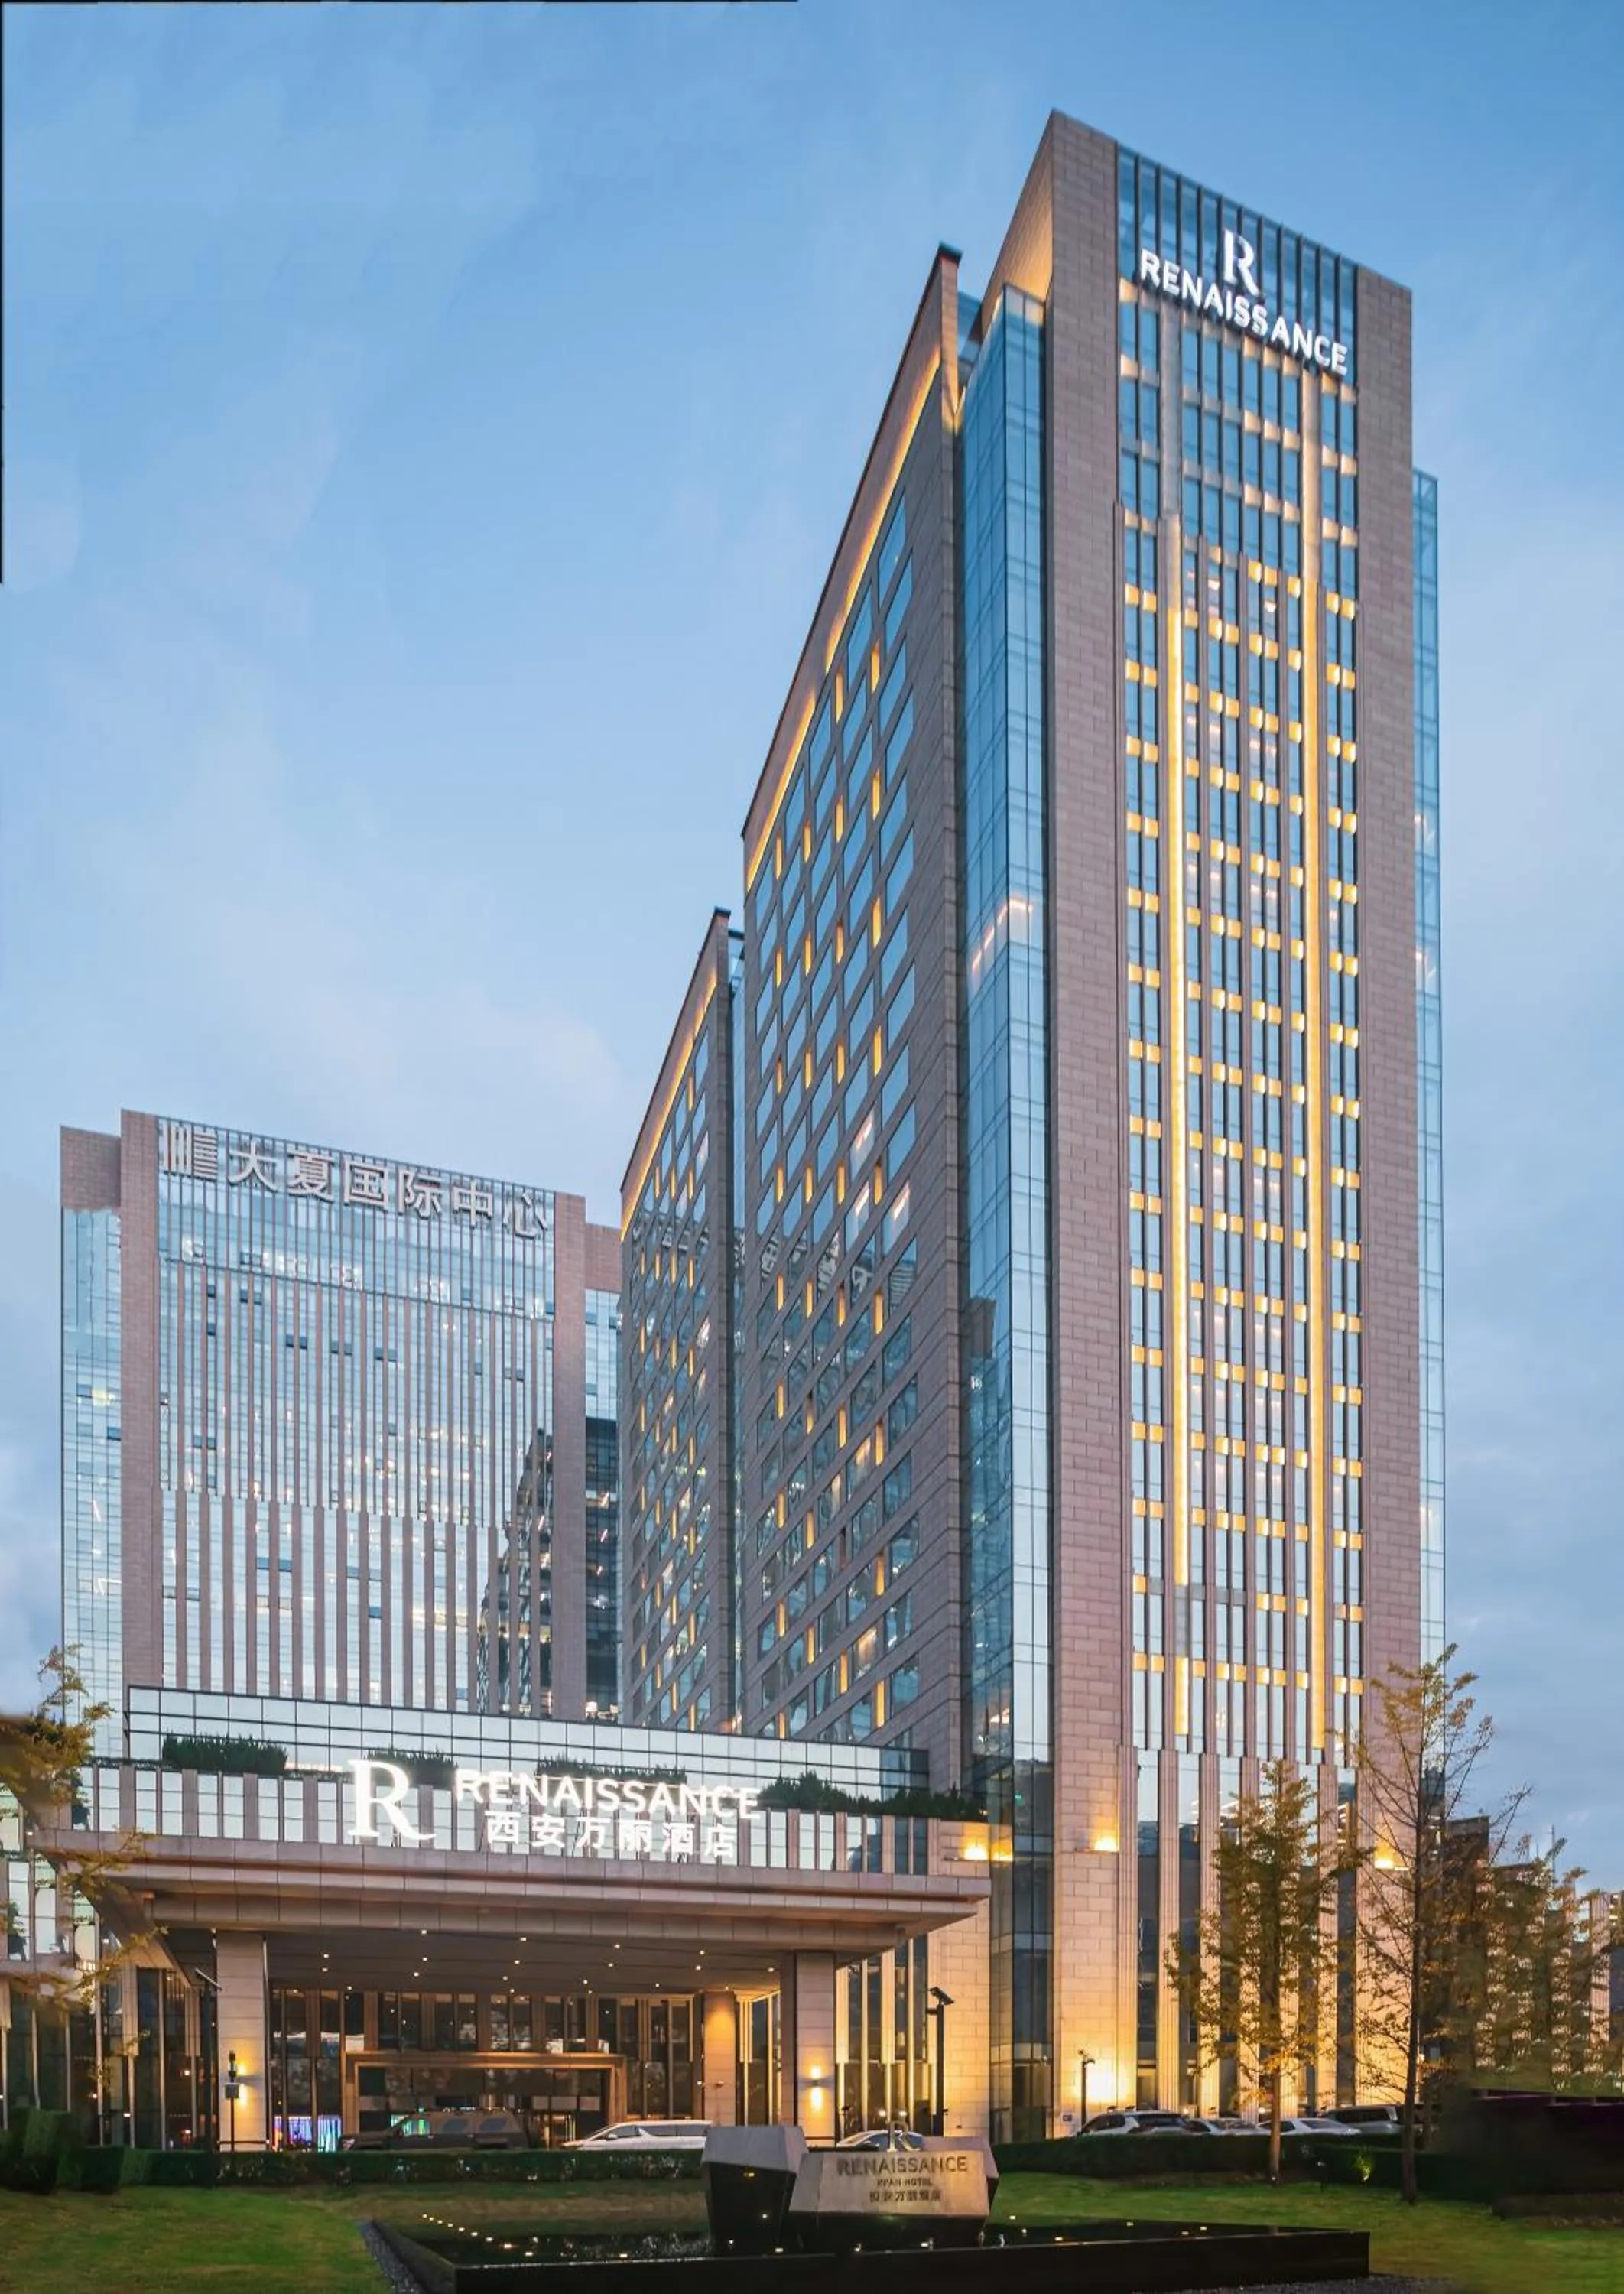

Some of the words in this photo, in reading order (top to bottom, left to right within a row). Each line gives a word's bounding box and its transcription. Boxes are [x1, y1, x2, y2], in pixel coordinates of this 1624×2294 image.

[1223, 229, 1260, 297] R
[1140, 248, 1348, 376] RENAISSANCE
[346, 1759, 438, 1841] R
[454, 1767, 763, 1821] RENAISSANCE
[484, 1809, 739, 1860] 西安万丽酒店
[885, 2119, 921, 2153] R
[837, 2156, 968, 2176] RENAISSANCE
